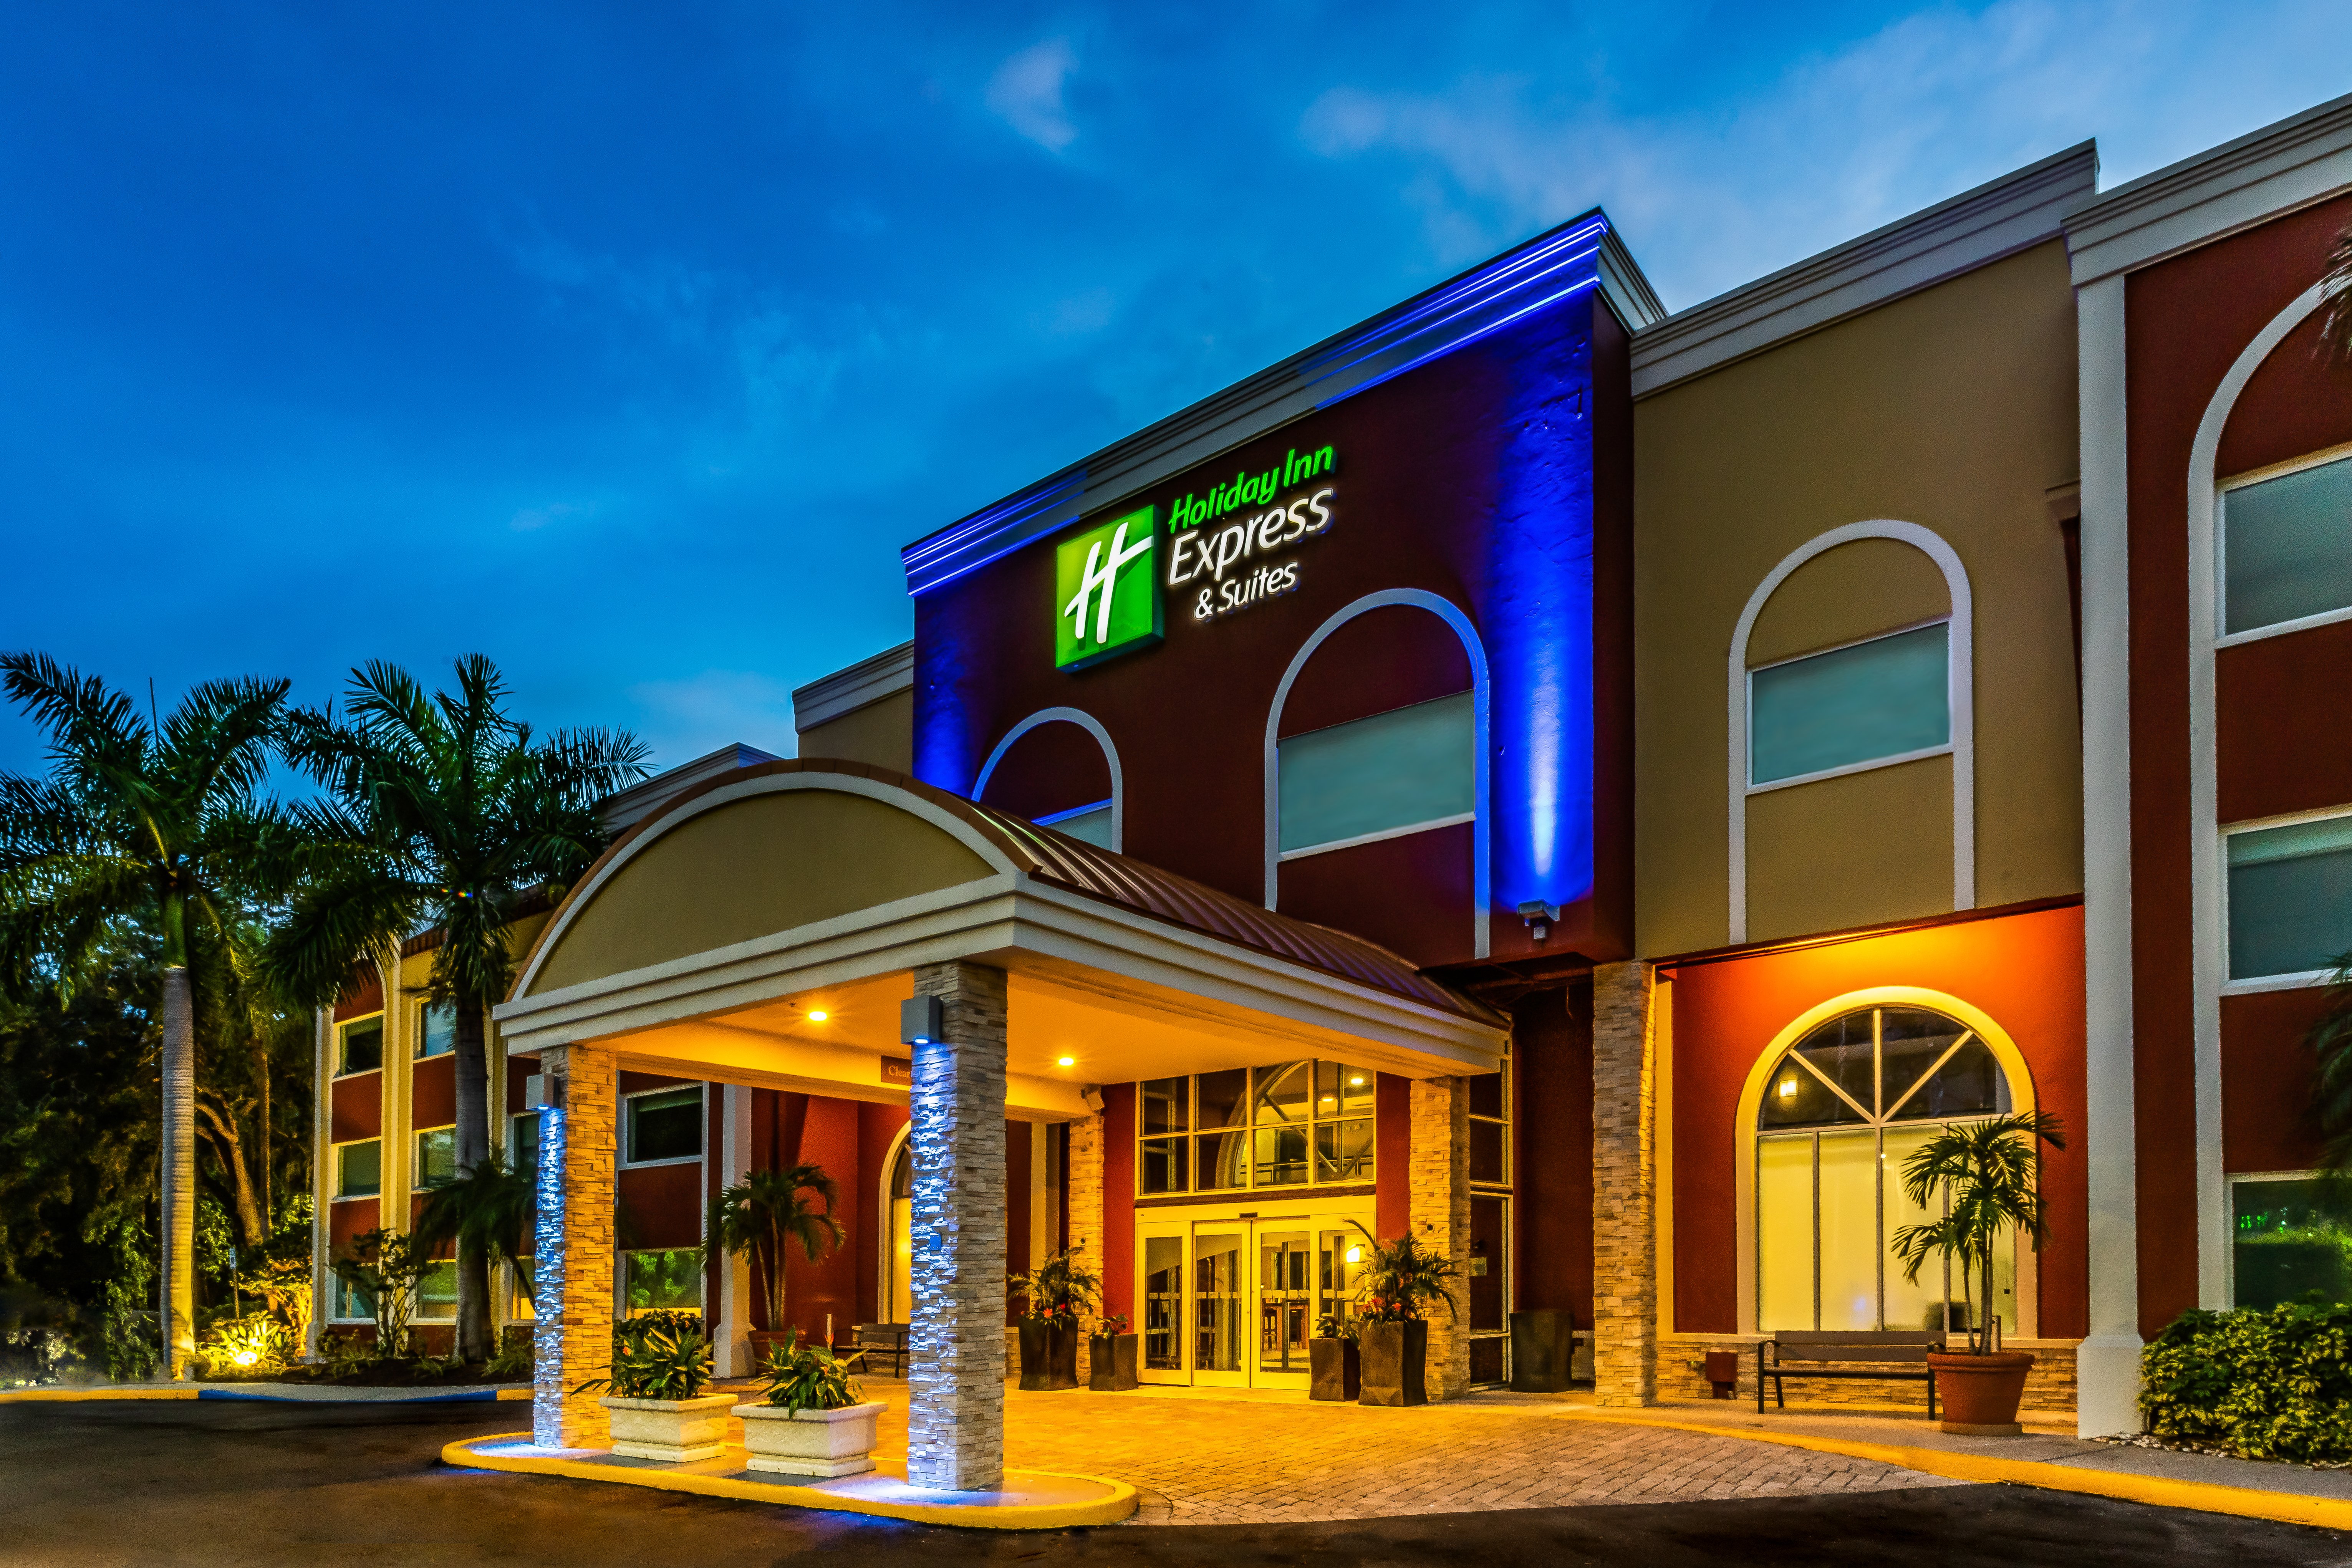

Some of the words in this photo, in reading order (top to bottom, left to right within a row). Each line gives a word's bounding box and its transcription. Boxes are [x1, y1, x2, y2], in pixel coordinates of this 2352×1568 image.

[1168, 467, 1280, 533] Holiday
[1284, 445, 1333, 487] Inn
[1169, 488, 1333, 585] Express
[1194, 587, 1214, 619] &
[1217, 562, 1299, 613] Suites
